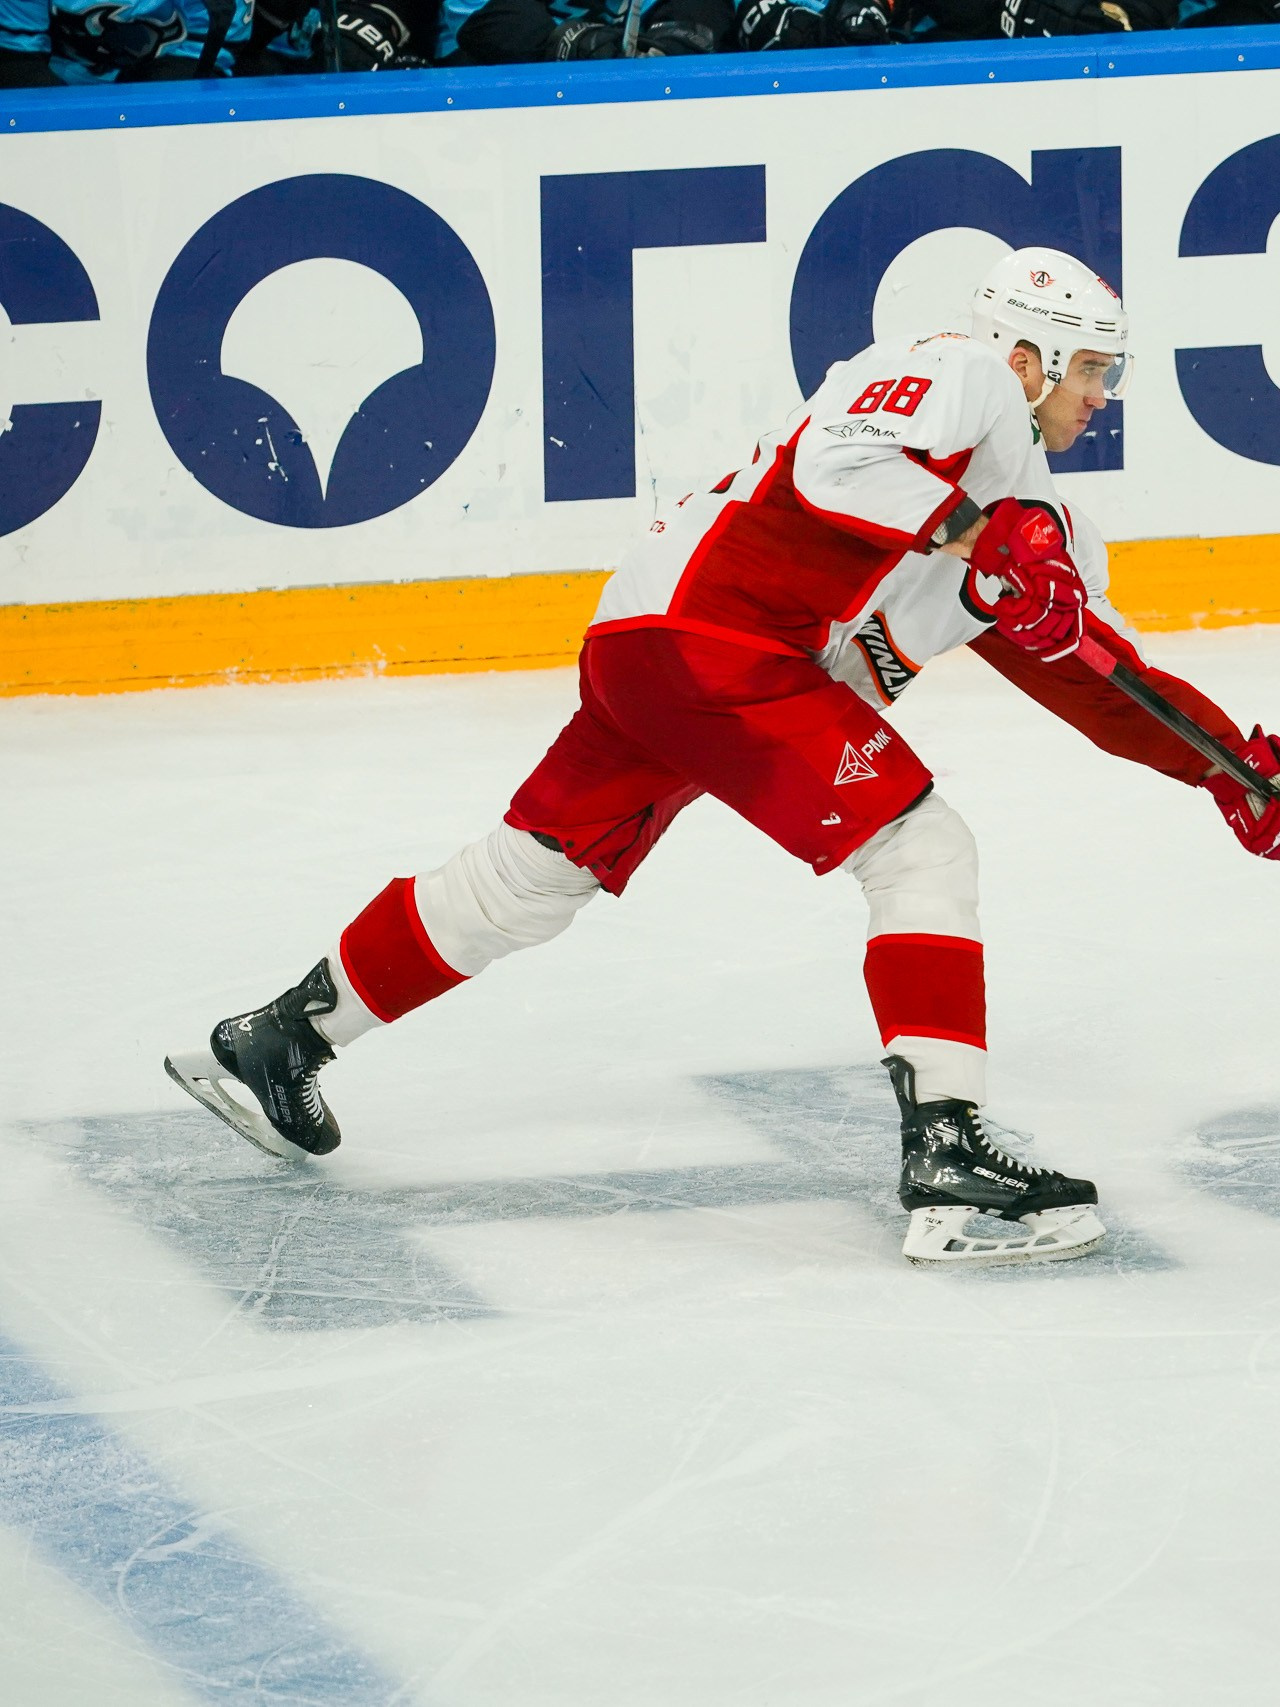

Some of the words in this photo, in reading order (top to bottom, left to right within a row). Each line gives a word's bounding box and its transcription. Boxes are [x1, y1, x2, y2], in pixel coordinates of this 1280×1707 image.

[337, 14, 394, 62] UER
[847, 375, 932, 417] 88
[972, 1166, 1029, 1191] BAUER
